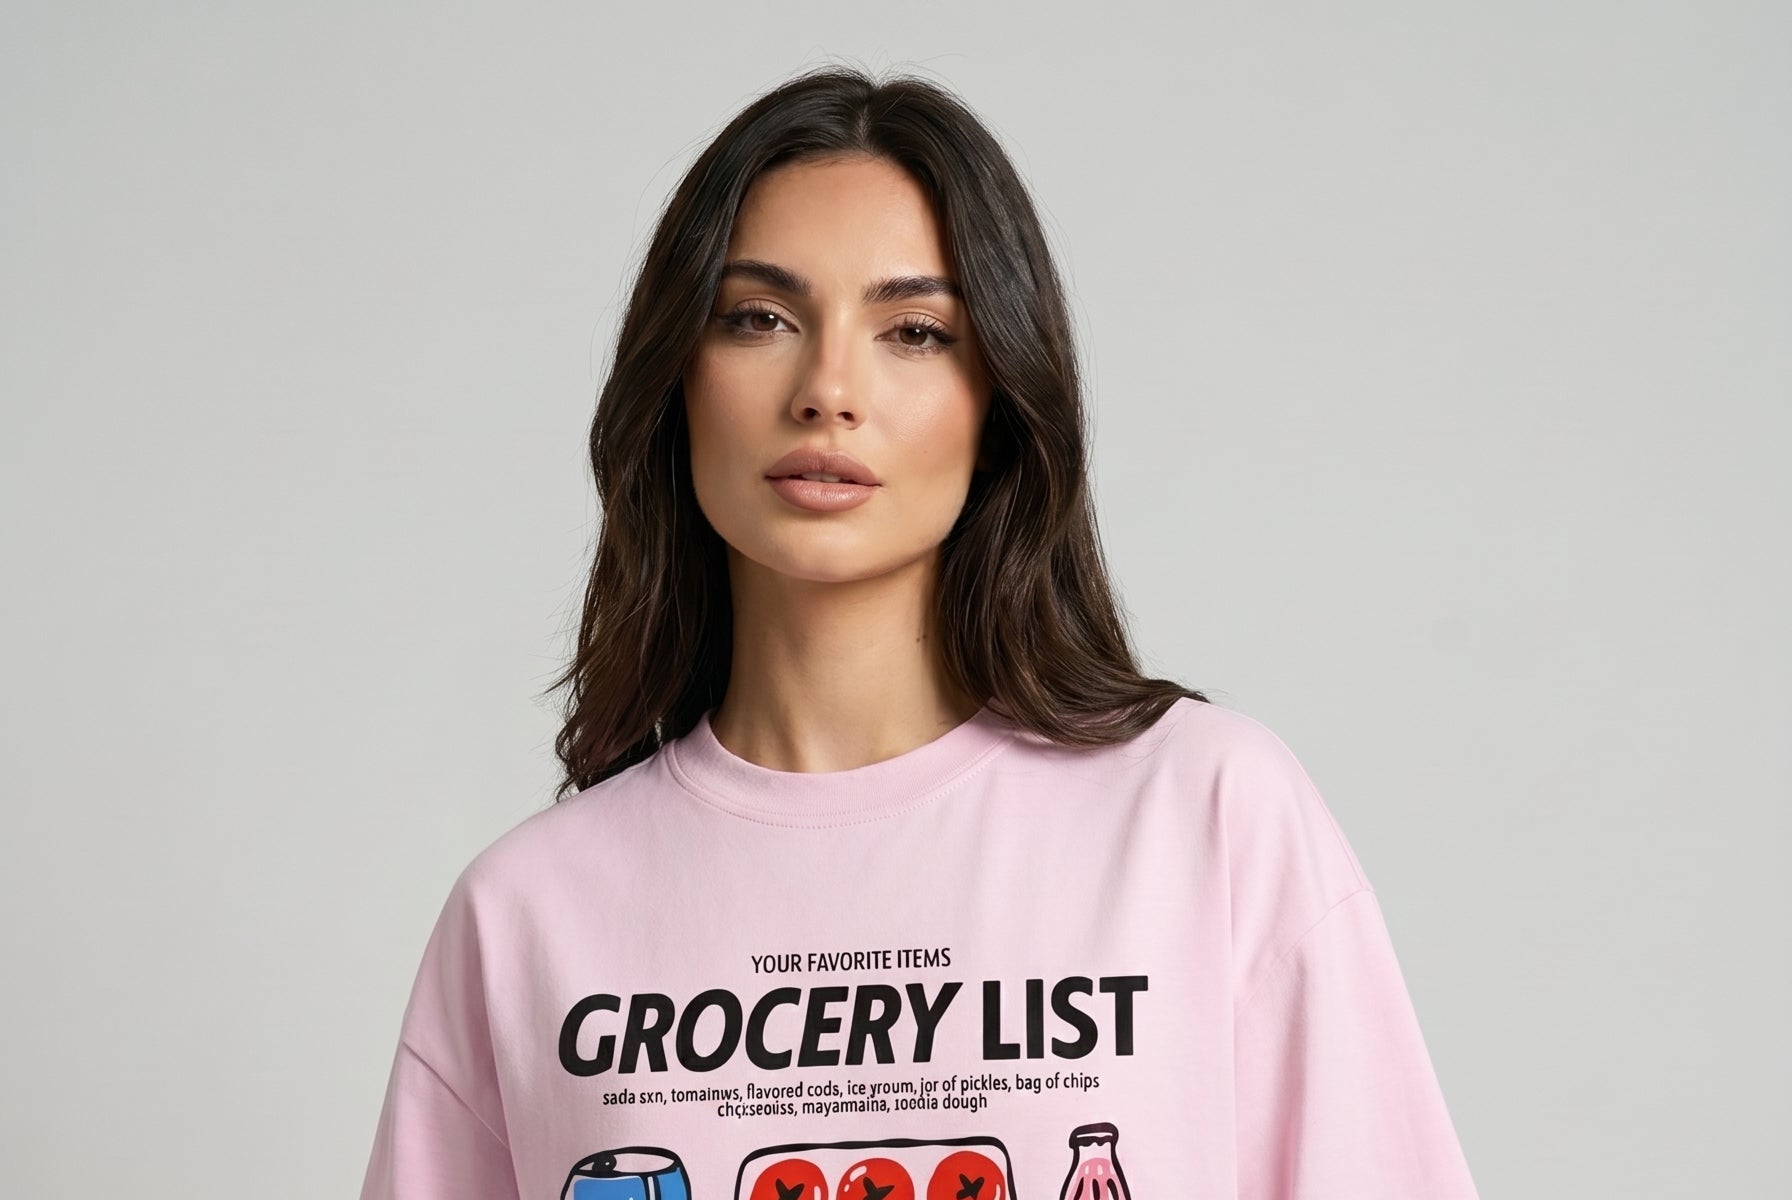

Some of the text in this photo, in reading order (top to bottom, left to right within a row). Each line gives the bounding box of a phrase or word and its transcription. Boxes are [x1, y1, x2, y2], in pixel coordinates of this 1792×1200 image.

[751, 947, 951, 974] YOUR FAVORITE ITEMS
[558, 975, 1149, 1078] GROCERY LIST
[602, 1088, 636, 1106] sada
[747, 1082, 804, 1100] flavored
[807, 1080, 843, 1099] cods,
[847, 1080, 866, 1096] ice
[942, 1074, 958, 1092] of
[960, 1073, 1011, 1096] pickles,
[1015, 1073, 1041, 1094] bag
[1045, 1072, 1060, 1089] of
[1063, 1072, 1100, 1093] chips
[942, 1092, 988, 1114] dough
